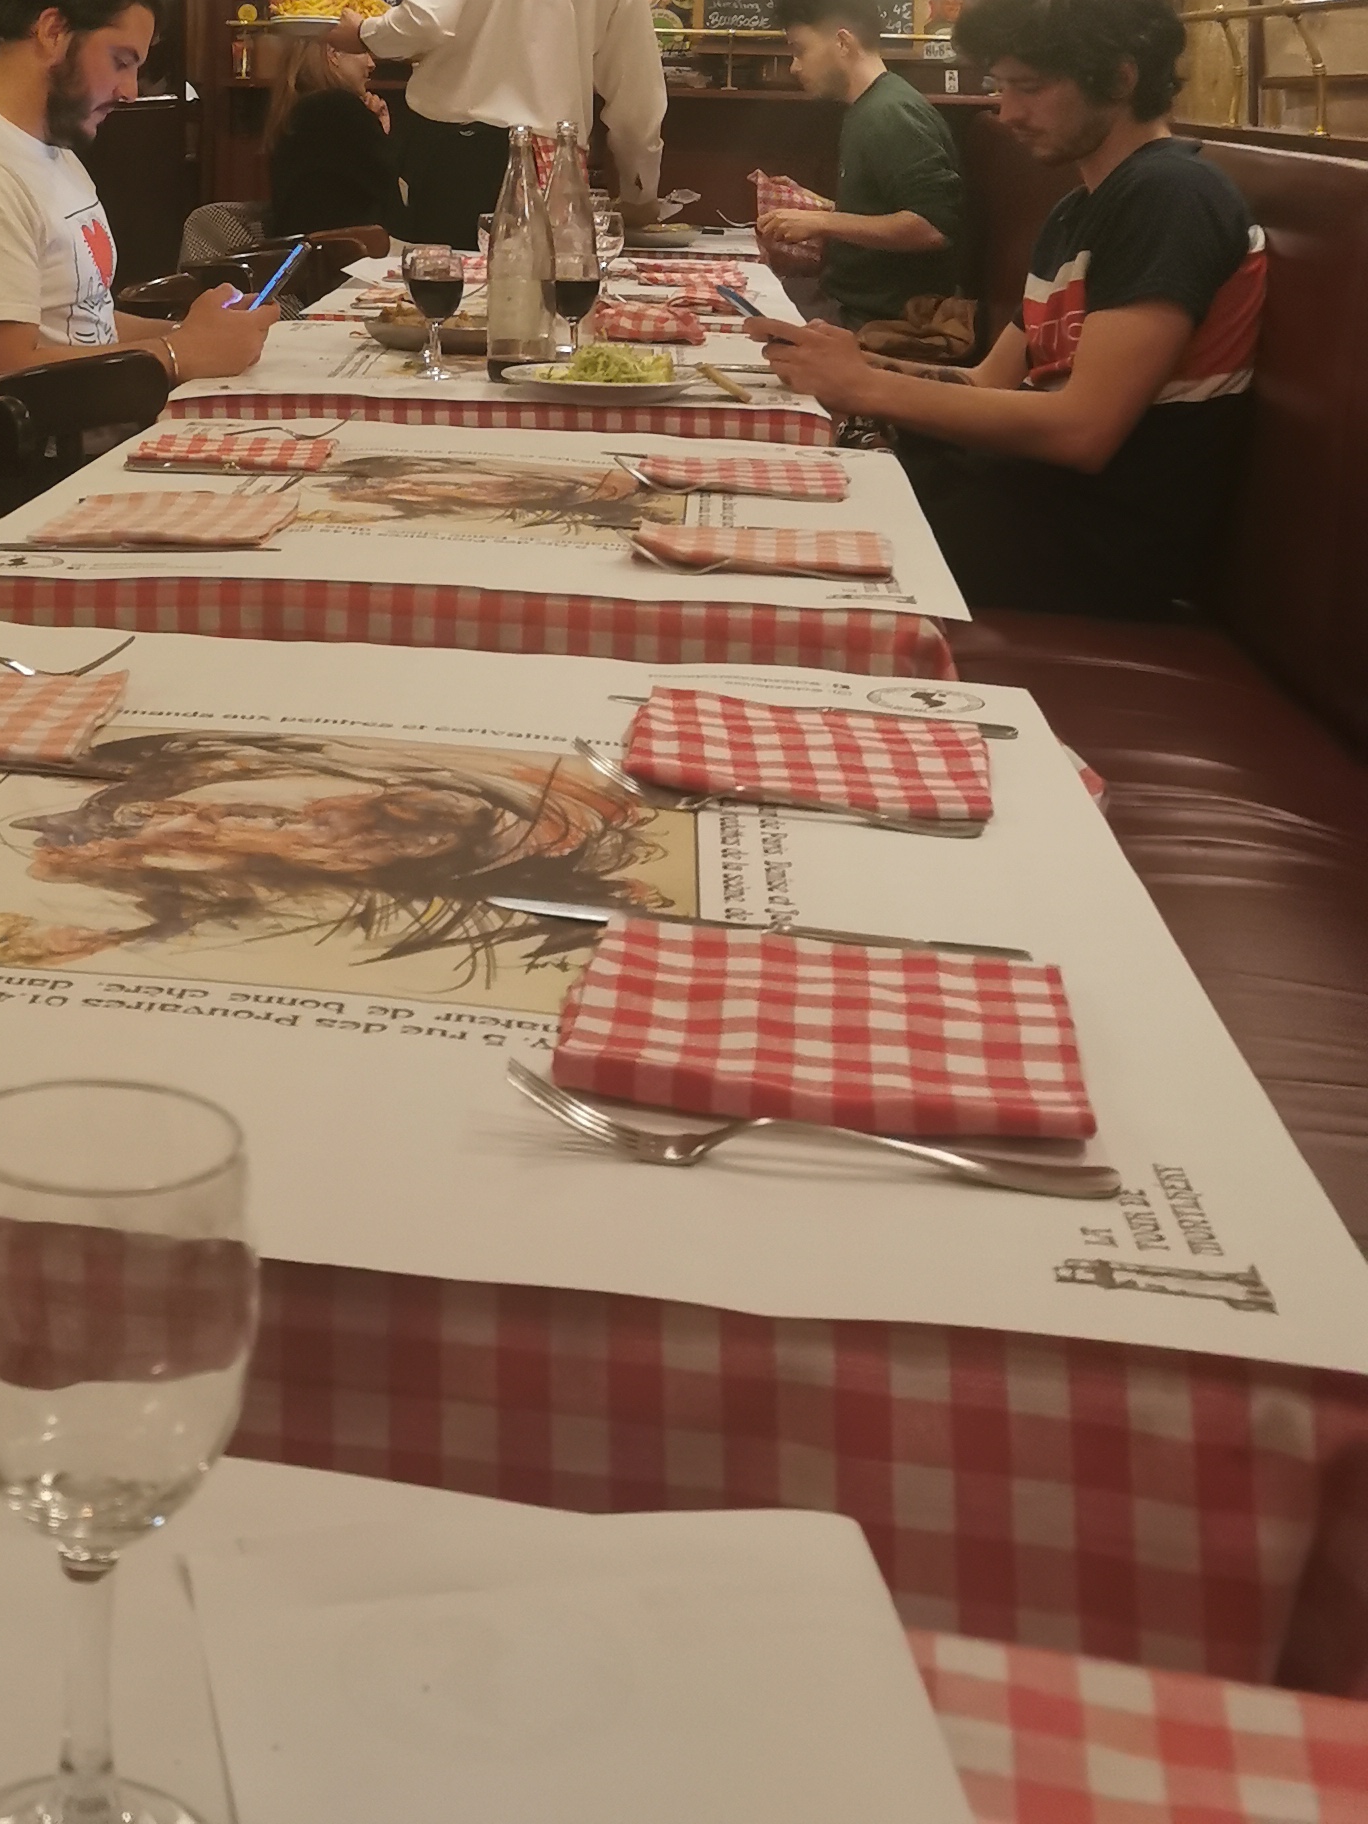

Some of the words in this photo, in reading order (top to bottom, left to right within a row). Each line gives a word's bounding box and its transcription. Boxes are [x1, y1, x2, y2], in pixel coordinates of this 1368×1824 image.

[81, 996, 300, 1027] Prouvaires
[227, 991, 346, 1014] bonne
[367, 1005, 416, 1020] de
[316, 1017, 388, 1035] des
[401, 1024, 468, 1041] rue
